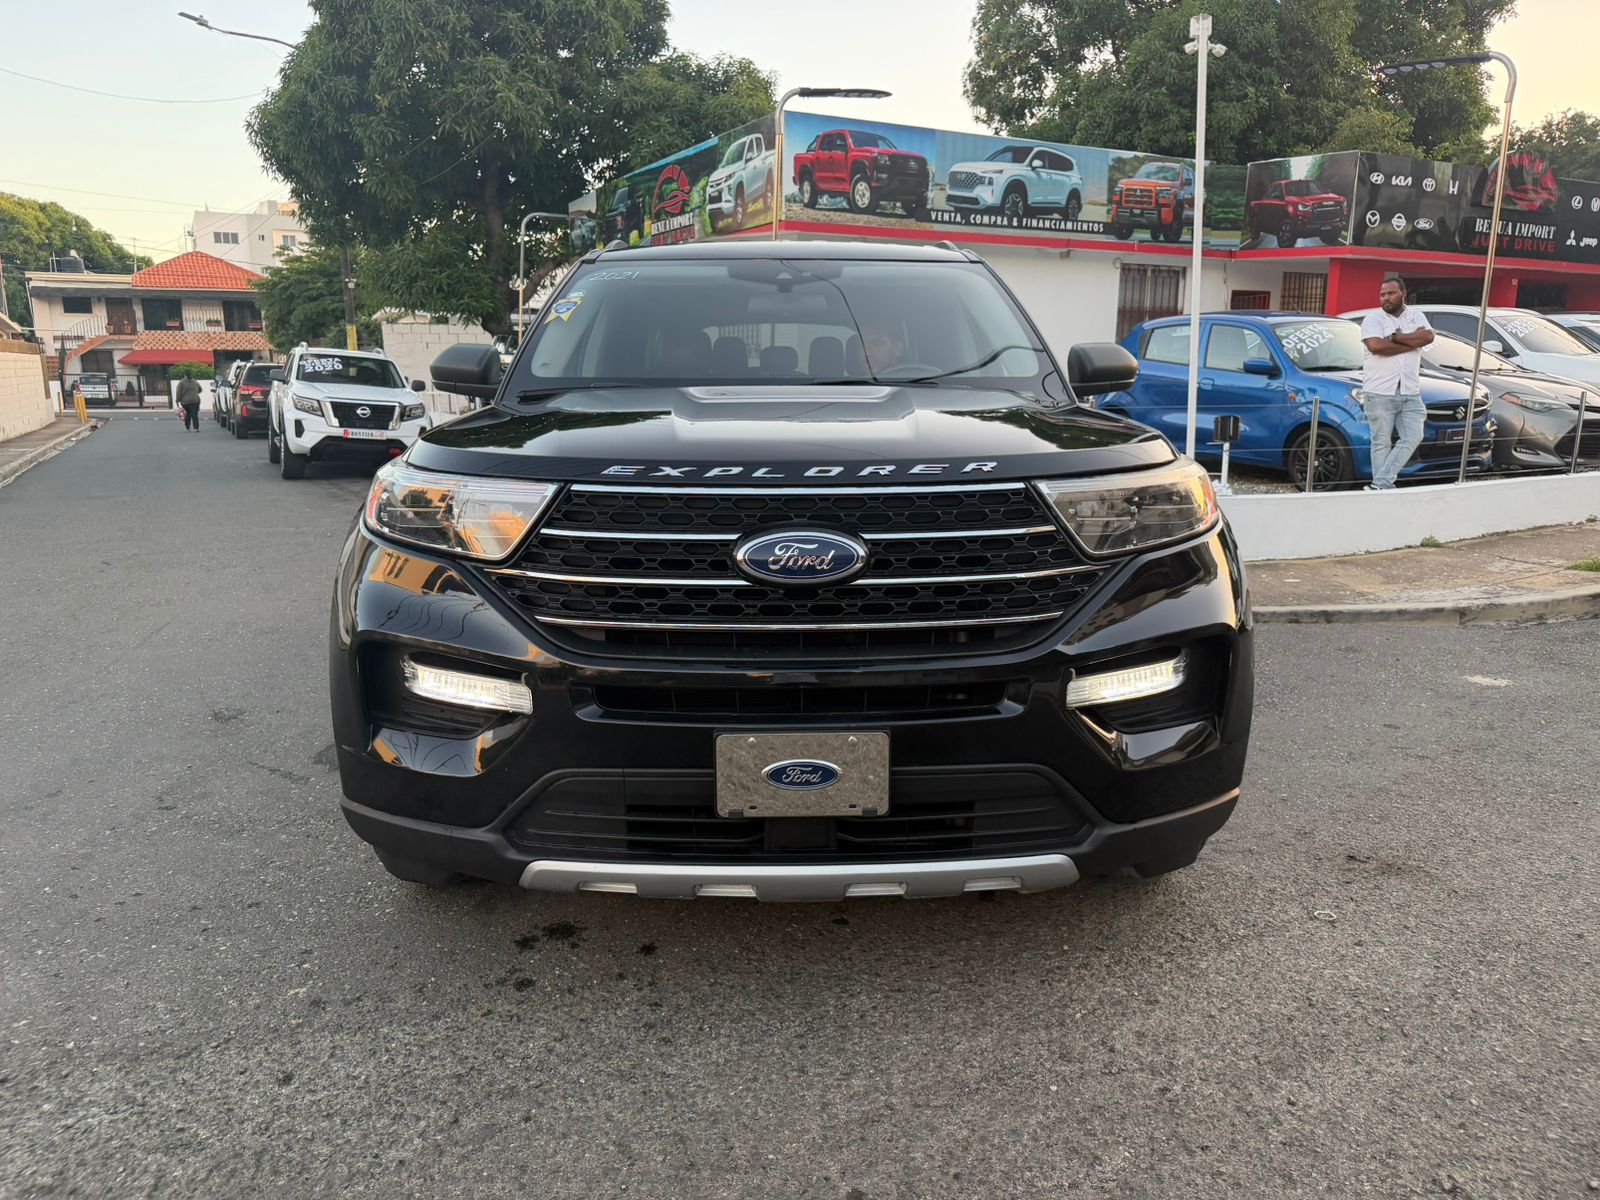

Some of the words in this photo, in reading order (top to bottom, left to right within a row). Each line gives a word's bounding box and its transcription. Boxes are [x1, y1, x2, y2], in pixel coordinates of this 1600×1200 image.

[930, 210, 965, 224] VENTA,
[970, 214, 1008, 226] COMPRA
[1012, 216, 1018, 226] &
[1022, 217, 1104, 232] FINANCIAMIENTOS
[1475, 217, 1512, 235] BEUA
[1515, 222, 1556, 240] IMPORT
[1514, 237, 1556, 253] DRIVE
[1579, 236, 1598, 247] Jeep
[589, 270, 640, 282] 2021
[1281, 322, 1329, 348] OFERTA
[1296, 330, 1335, 354] 2024
[304, 363, 344, 373] 2020
[600, 460, 998, 480] EXPLORER
[767, 541, 835, 571] Ford
[782, 766, 823, 784] Ford
